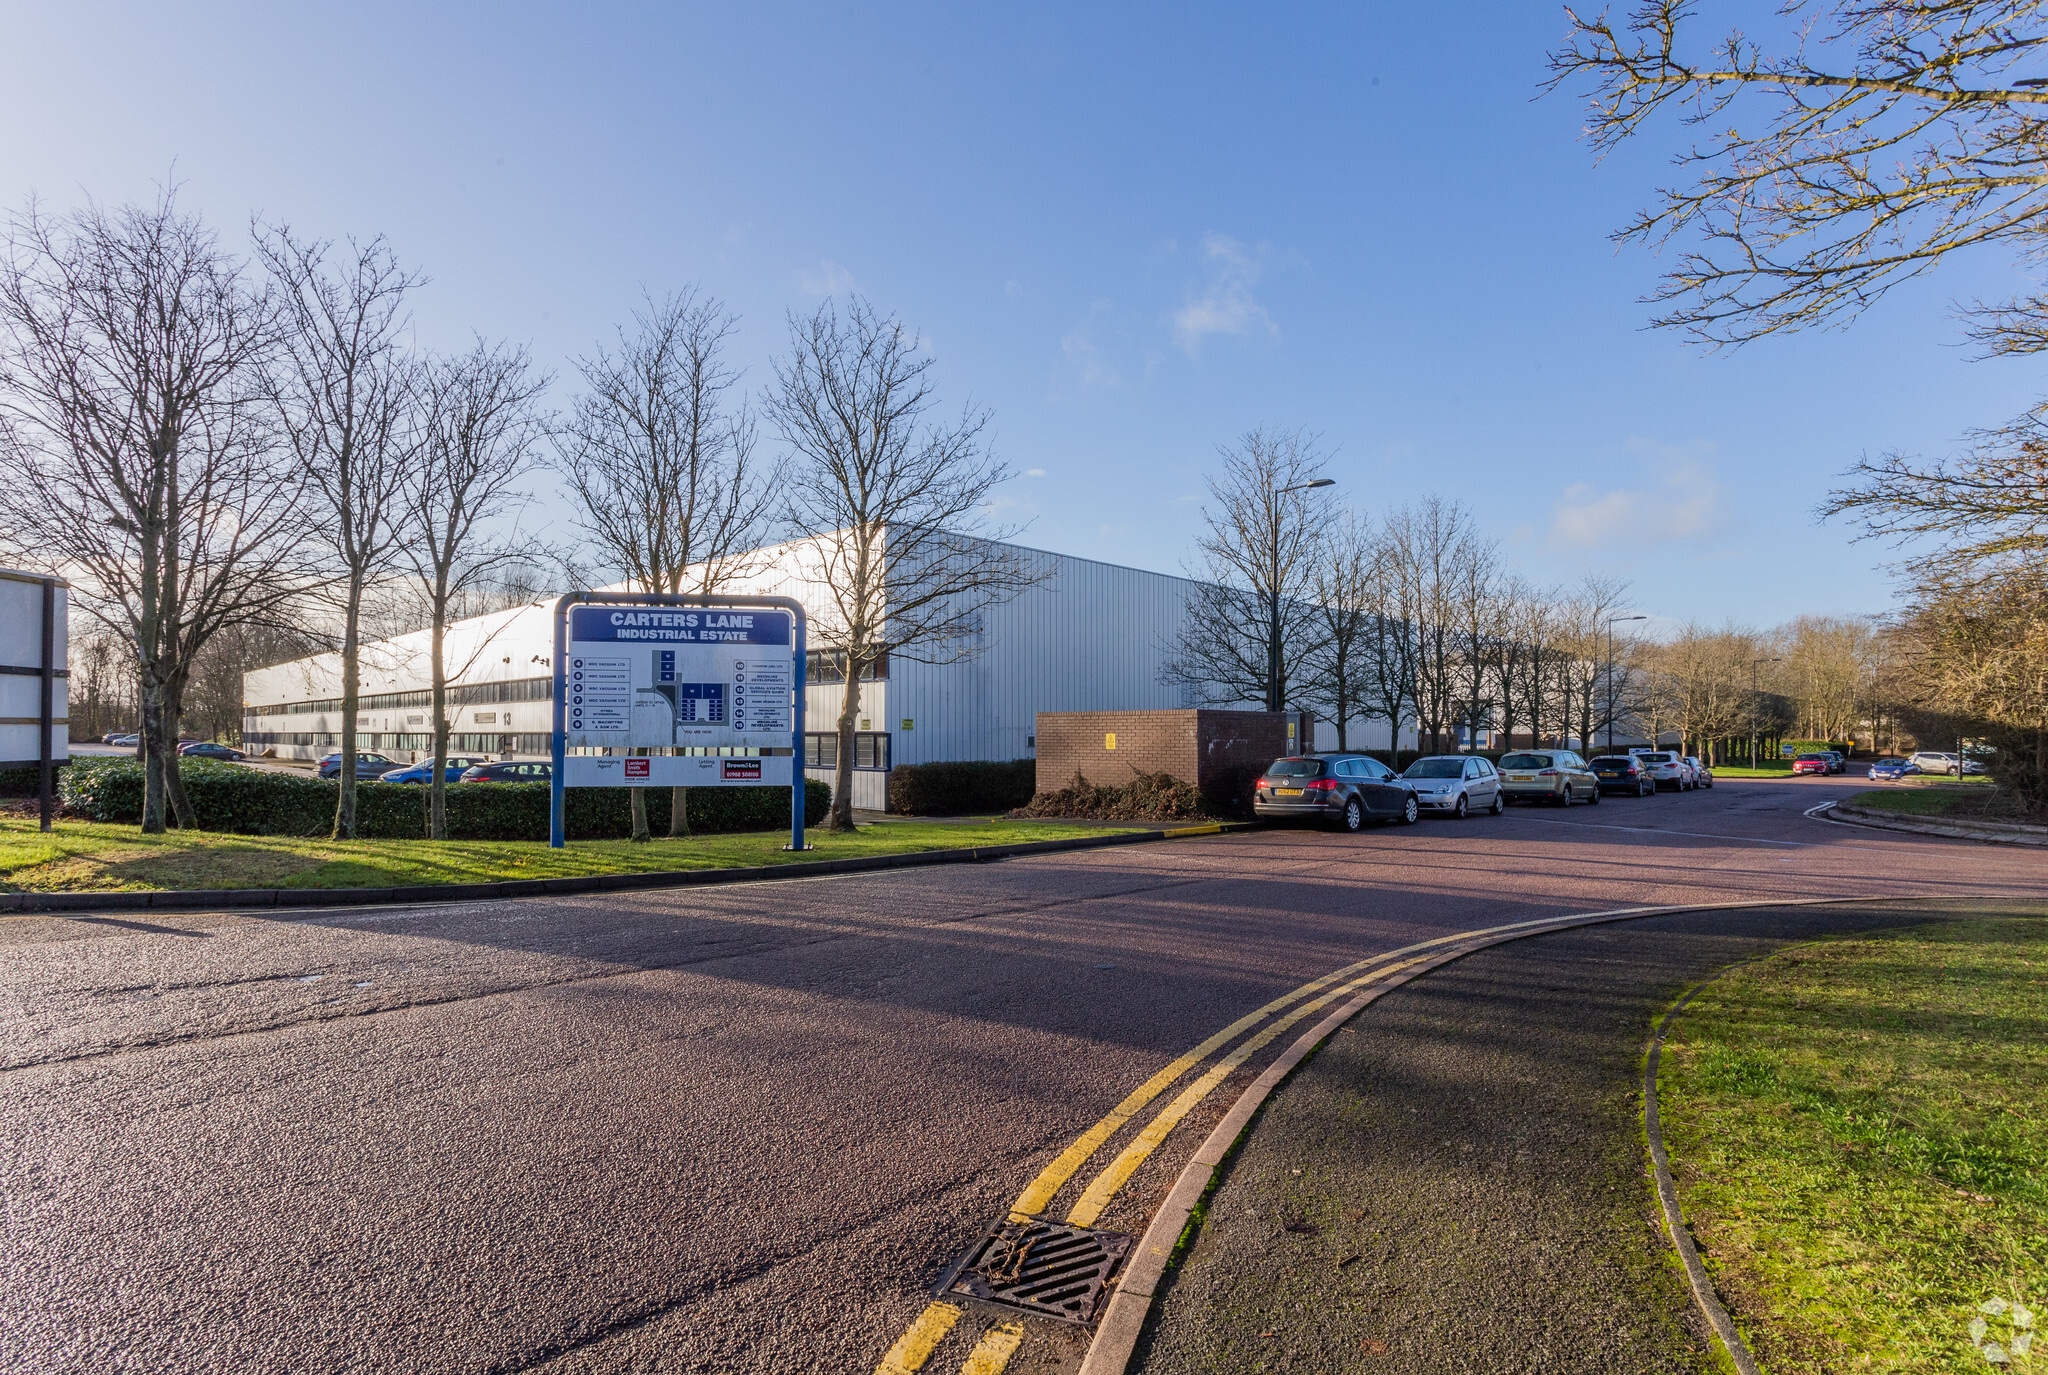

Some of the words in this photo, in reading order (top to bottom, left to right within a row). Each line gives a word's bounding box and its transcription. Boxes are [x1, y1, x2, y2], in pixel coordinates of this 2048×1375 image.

[610, 612, 699, 627] CARTERS
[706, 614, 754, 629] LANE
[617, 629, 695, 640] INDUSTRIAL
[700, 630, 748, 641] ESTATE
[503, 712, 511, 726] 13
